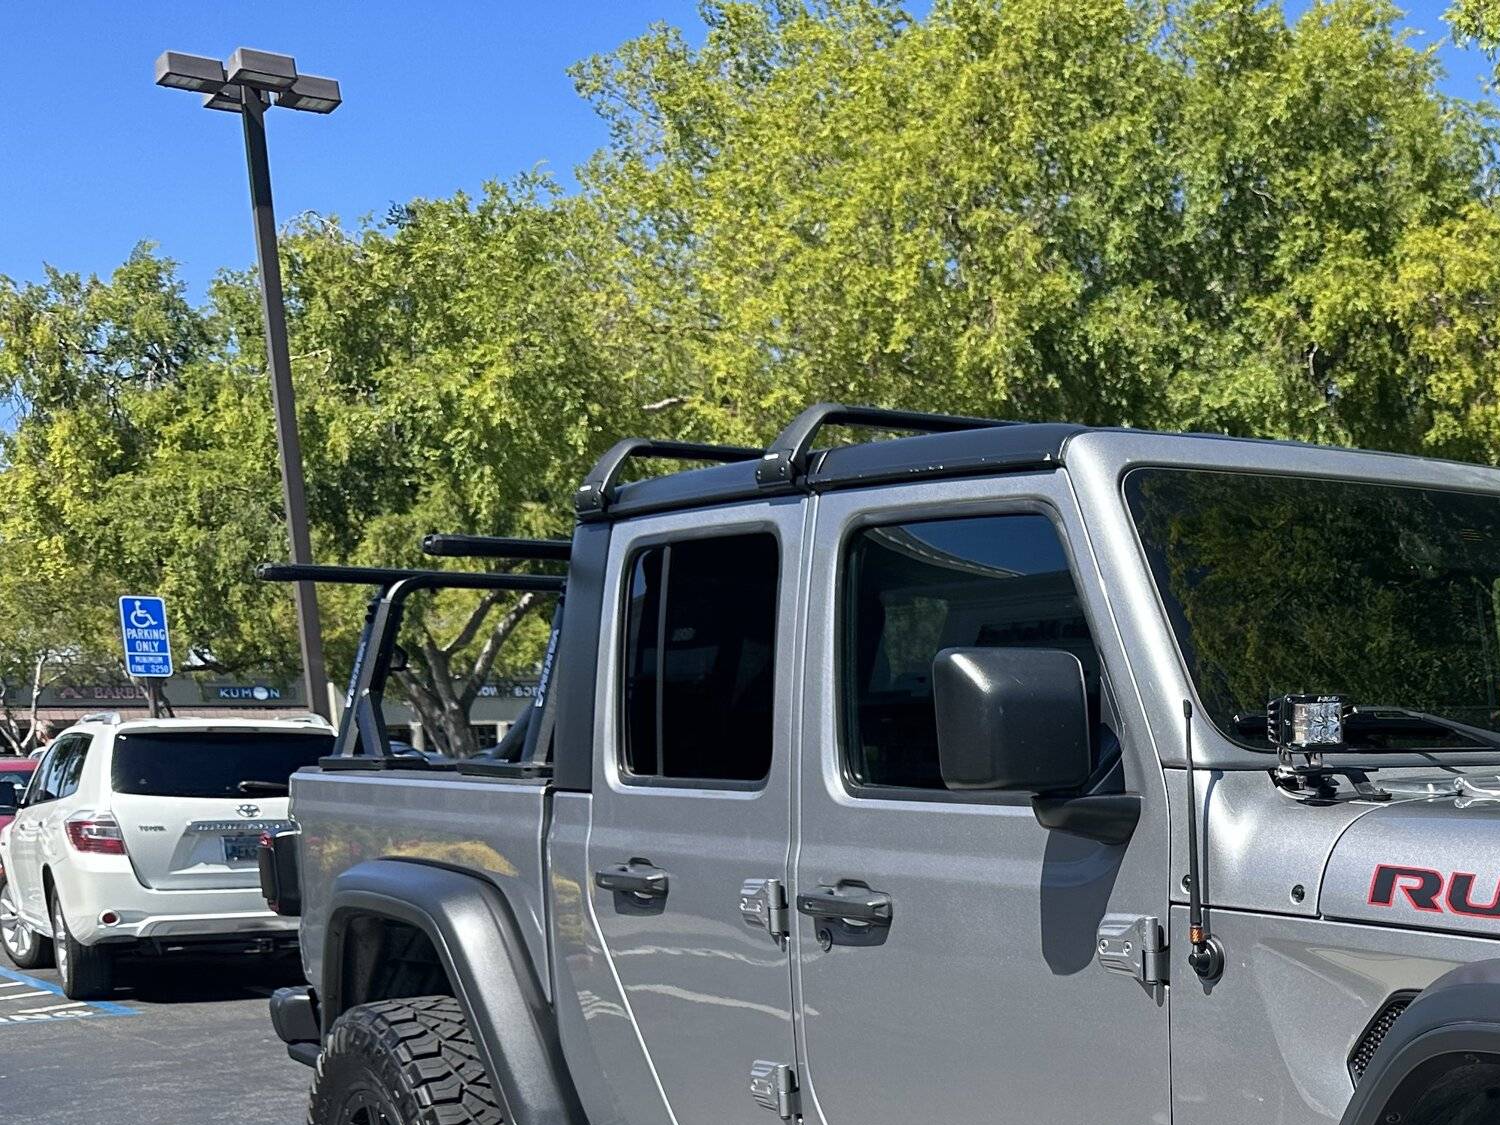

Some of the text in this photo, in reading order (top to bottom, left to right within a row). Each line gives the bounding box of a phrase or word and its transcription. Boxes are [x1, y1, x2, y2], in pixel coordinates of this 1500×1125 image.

[126, 628, 166, 641] PARKING
[135, 640, 160, 652] ONLY
[150, 664, 169, 673] $250
[94, 687, 147, 699] BARBE
[219, 686, 280, 700] KUMON
